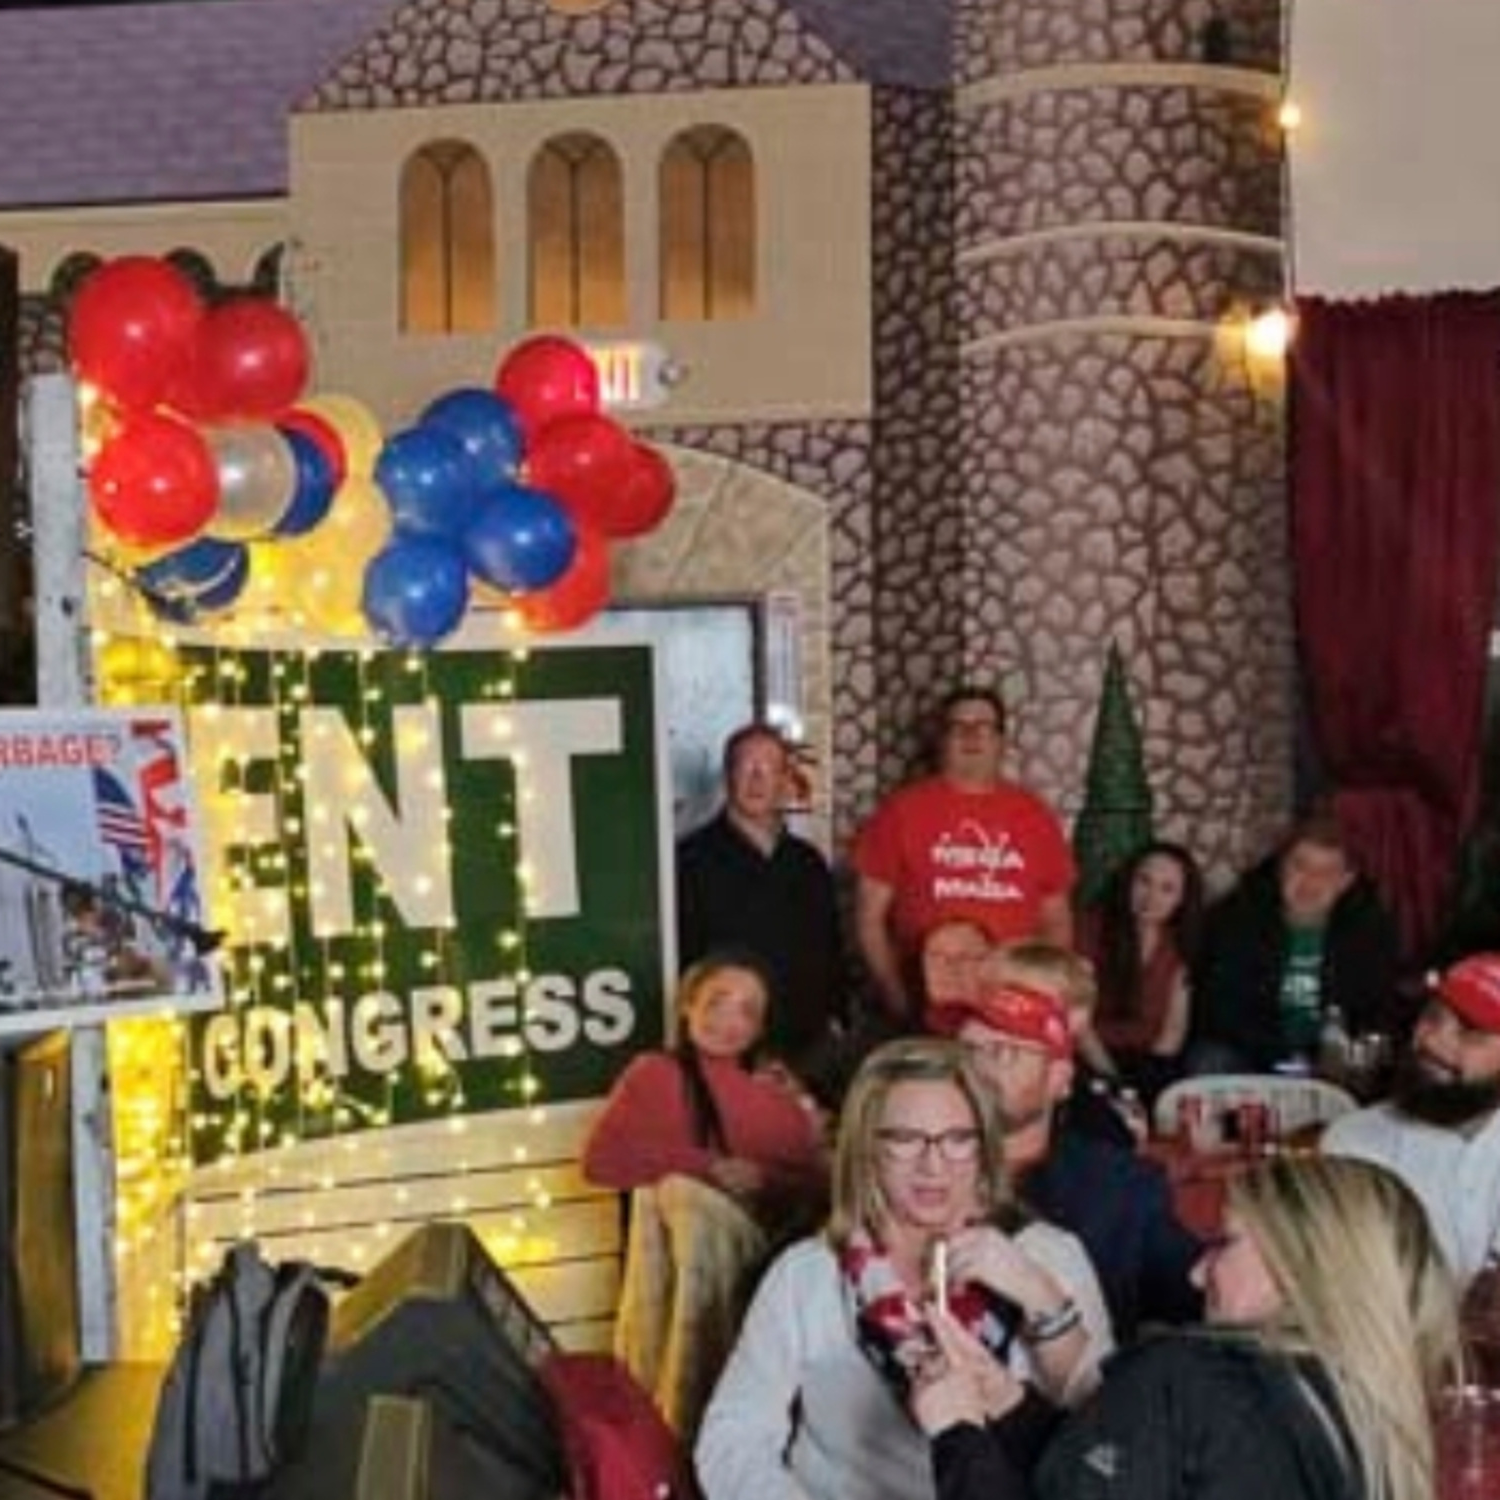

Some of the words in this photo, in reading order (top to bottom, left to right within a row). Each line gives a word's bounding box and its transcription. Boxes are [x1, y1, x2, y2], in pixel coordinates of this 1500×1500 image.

[588, 347, 642, 401] XIT
[189, 696, 623, 946] ENT
[203, 969, 636, 1101] CONGRESS
